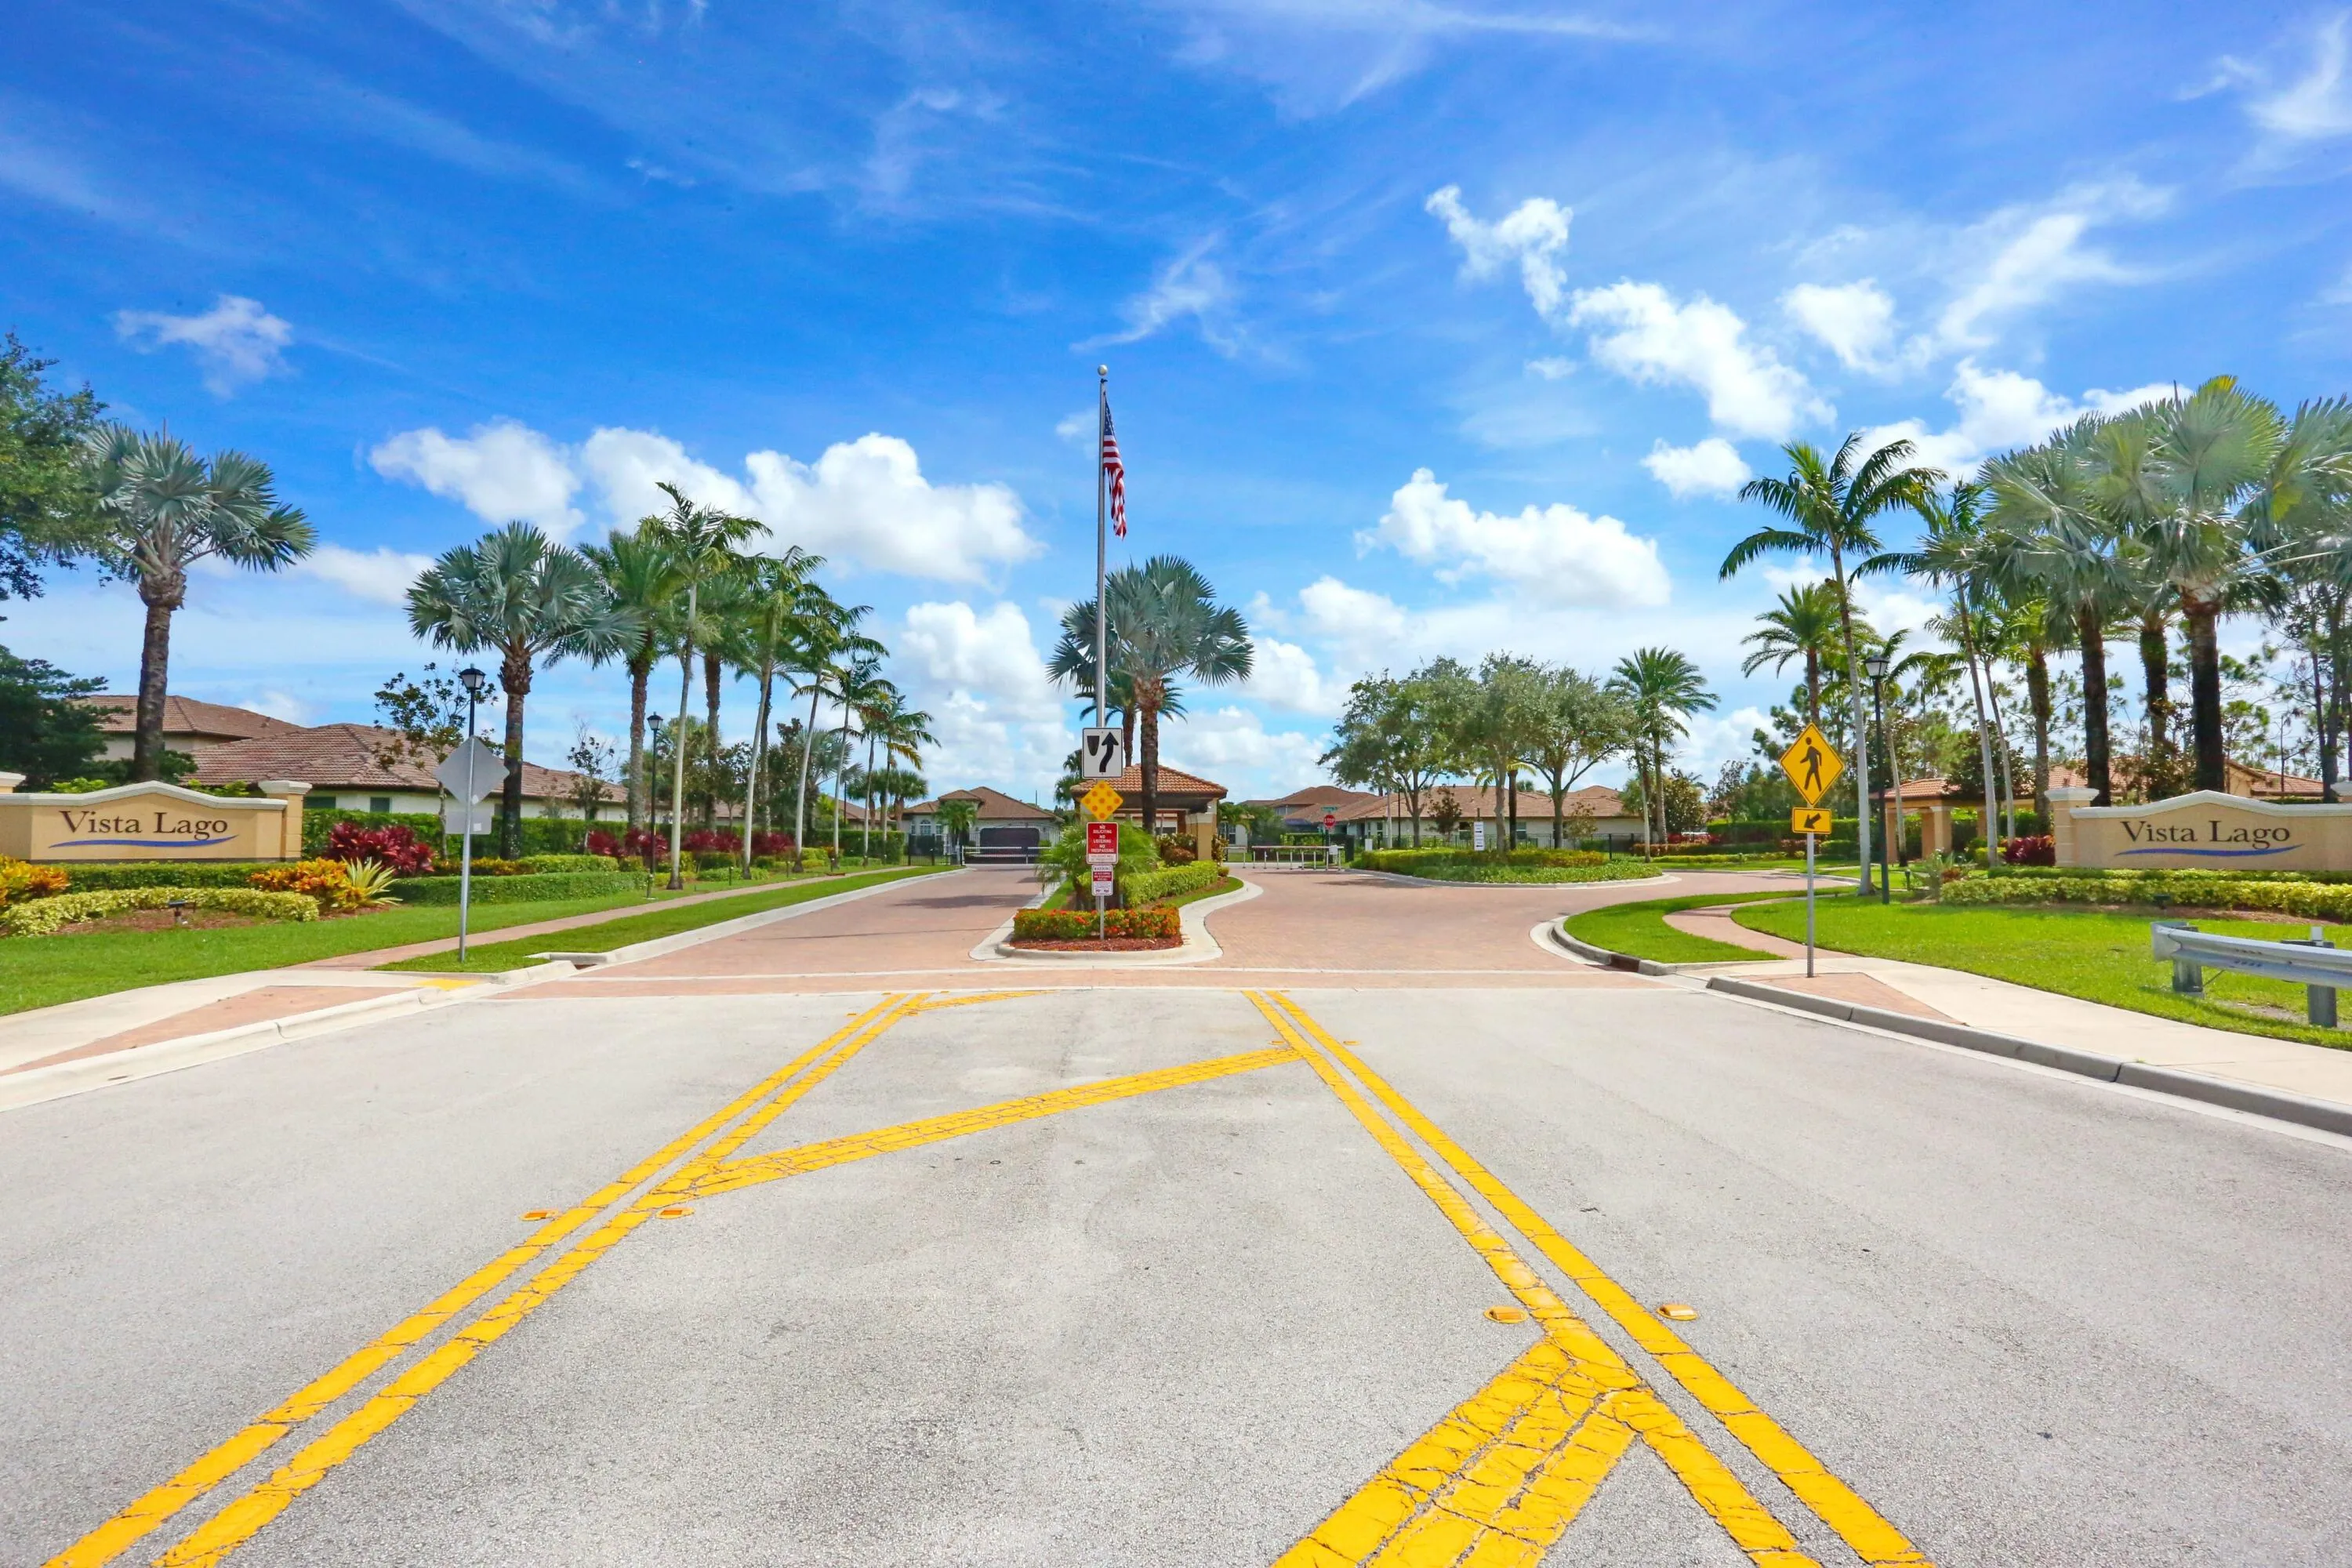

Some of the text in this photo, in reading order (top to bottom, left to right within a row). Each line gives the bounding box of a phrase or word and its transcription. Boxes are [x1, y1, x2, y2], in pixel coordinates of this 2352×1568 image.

[59, 810, 229, 840] Vista Lago
[2120, 820, 2291, 849] Vista Lago
